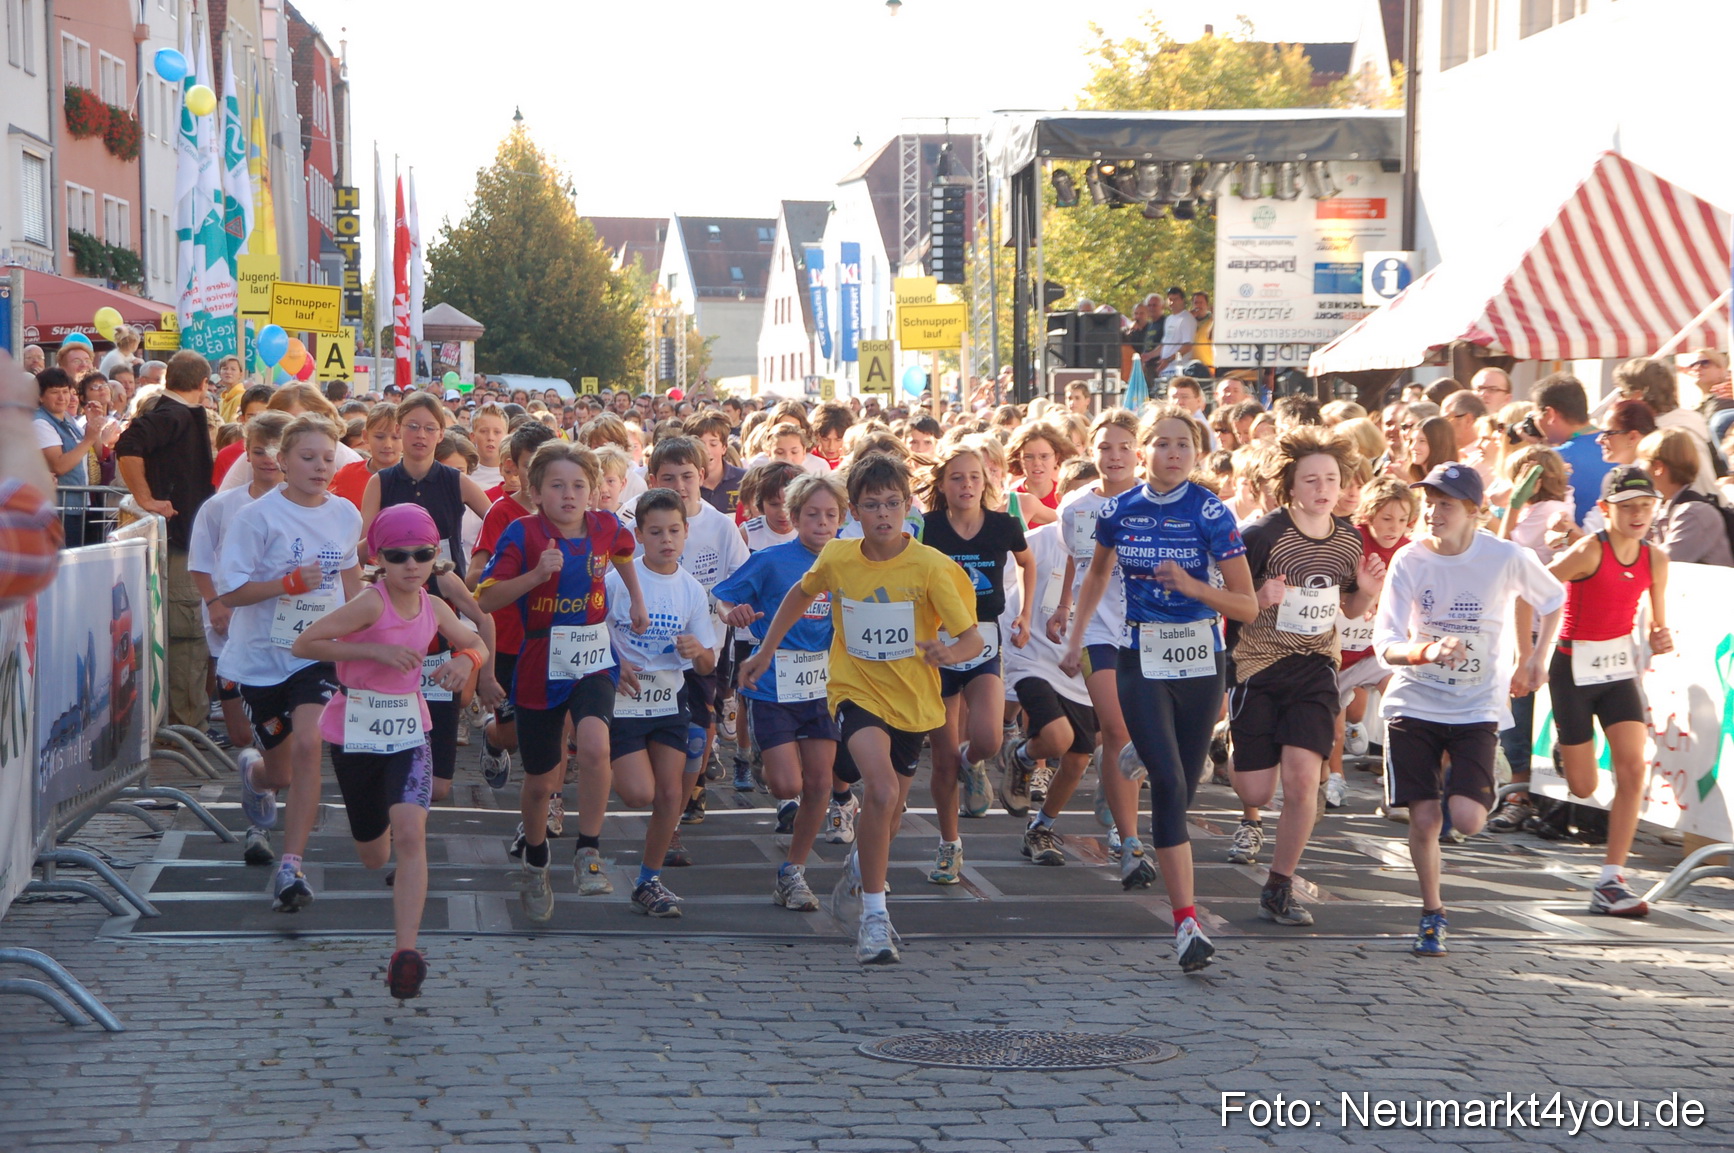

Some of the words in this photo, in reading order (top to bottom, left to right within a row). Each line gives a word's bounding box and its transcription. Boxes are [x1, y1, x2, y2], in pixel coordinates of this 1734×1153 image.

[337, 188, 360, 316] HOTEL
[240, 272, 279, 284] Jugend-
[250, 284, 269, 295] lauf
[275, 296, 336, 310] Schnupper-
[896, 295, 936, 304] Jugend-
[295, 310, 315, 320] lauf
[903, 317, 962, 328] Schnupper-
[923, 329, 942, 339] lauf
[862, 342, 890, 352] Block
[324, 343, 345, 369] A
[866, 356, 887, 382] A
[824, 385, 832, 396] B
[296, 600, 325, 612] Corinna
[531, 593, 590, 614] unicef
[277, 612, 286, 621] Ju
[1298, 603, 1336, 620] 4056
[570, 631, 598, 642] Patrick
[861, 628, 909, 645] 4120
[1160, 628, 1196, 640] Isabella
[552, 648, 562, 656] Ju
[1143, 645, 1153, 653] Ju
[1162, 645, 1208, 663] 4008
[421, 656, 445, 668] stoph
[570, 648, 606, 667] 4107
[793, 652, 824, 664] Johannes
[1590, 652, 1628, 671] 4119
[778, 670, 787, 678] Ju
[795, 667, 827, 687] 4074
[631, 688, 672, 703] 4108
[368, 696, 408, 709] Vanessa
[349, 714, 359, 723] Ju
[369, 717, 417, 736] 4079
